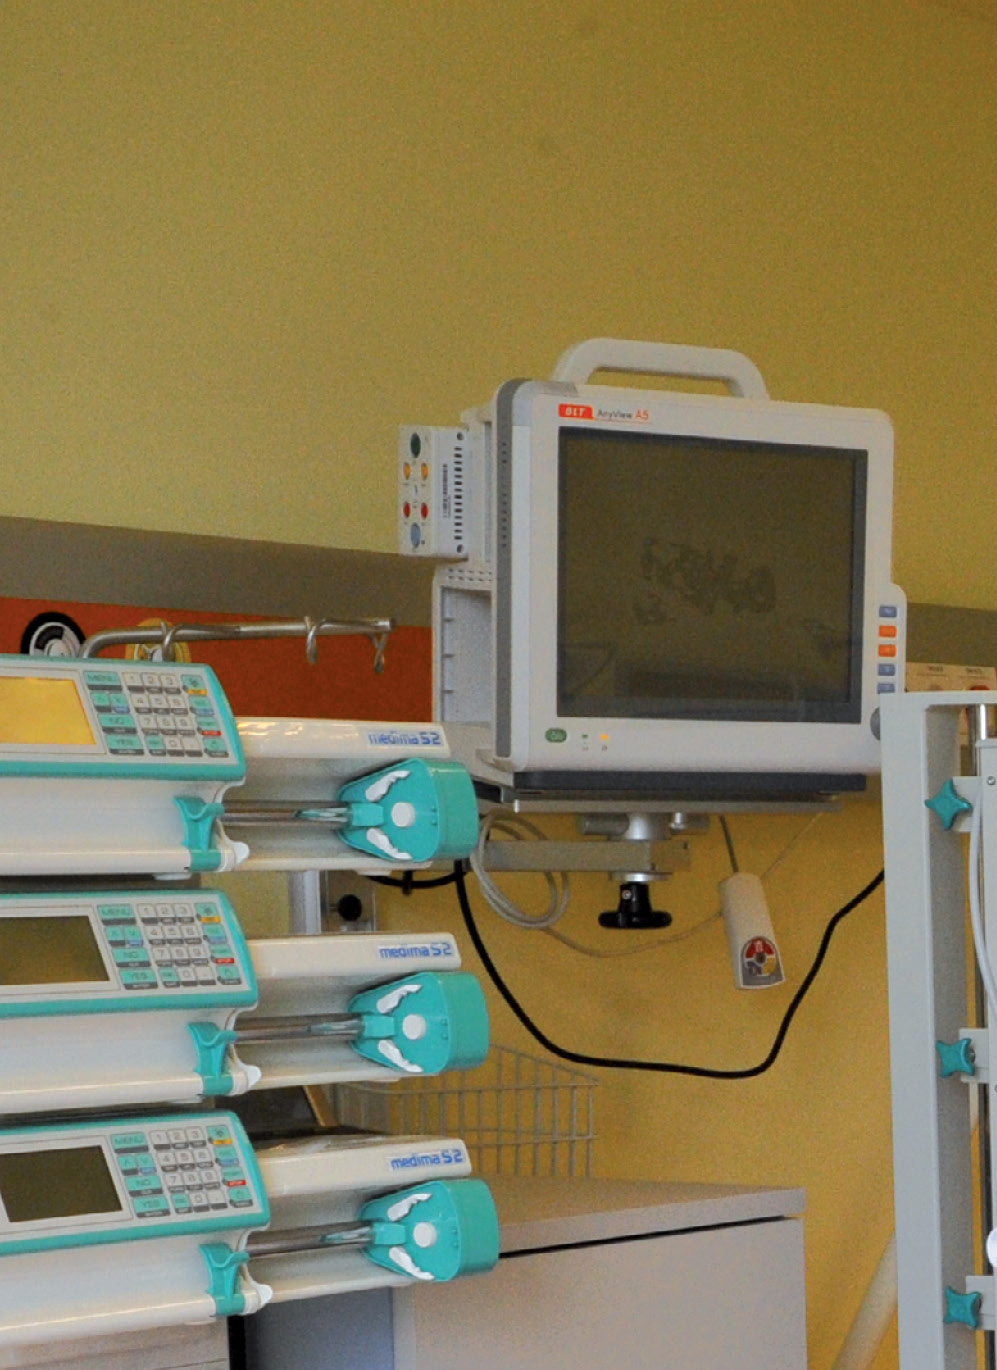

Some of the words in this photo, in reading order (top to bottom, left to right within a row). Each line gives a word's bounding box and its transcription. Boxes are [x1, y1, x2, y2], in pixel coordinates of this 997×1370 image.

[379, 944, 430, 959] medima
[430, 942, 453, 956] S2
[391, 1152, 440, 1170] medima
[441, 1148, 463, 1164] S2
